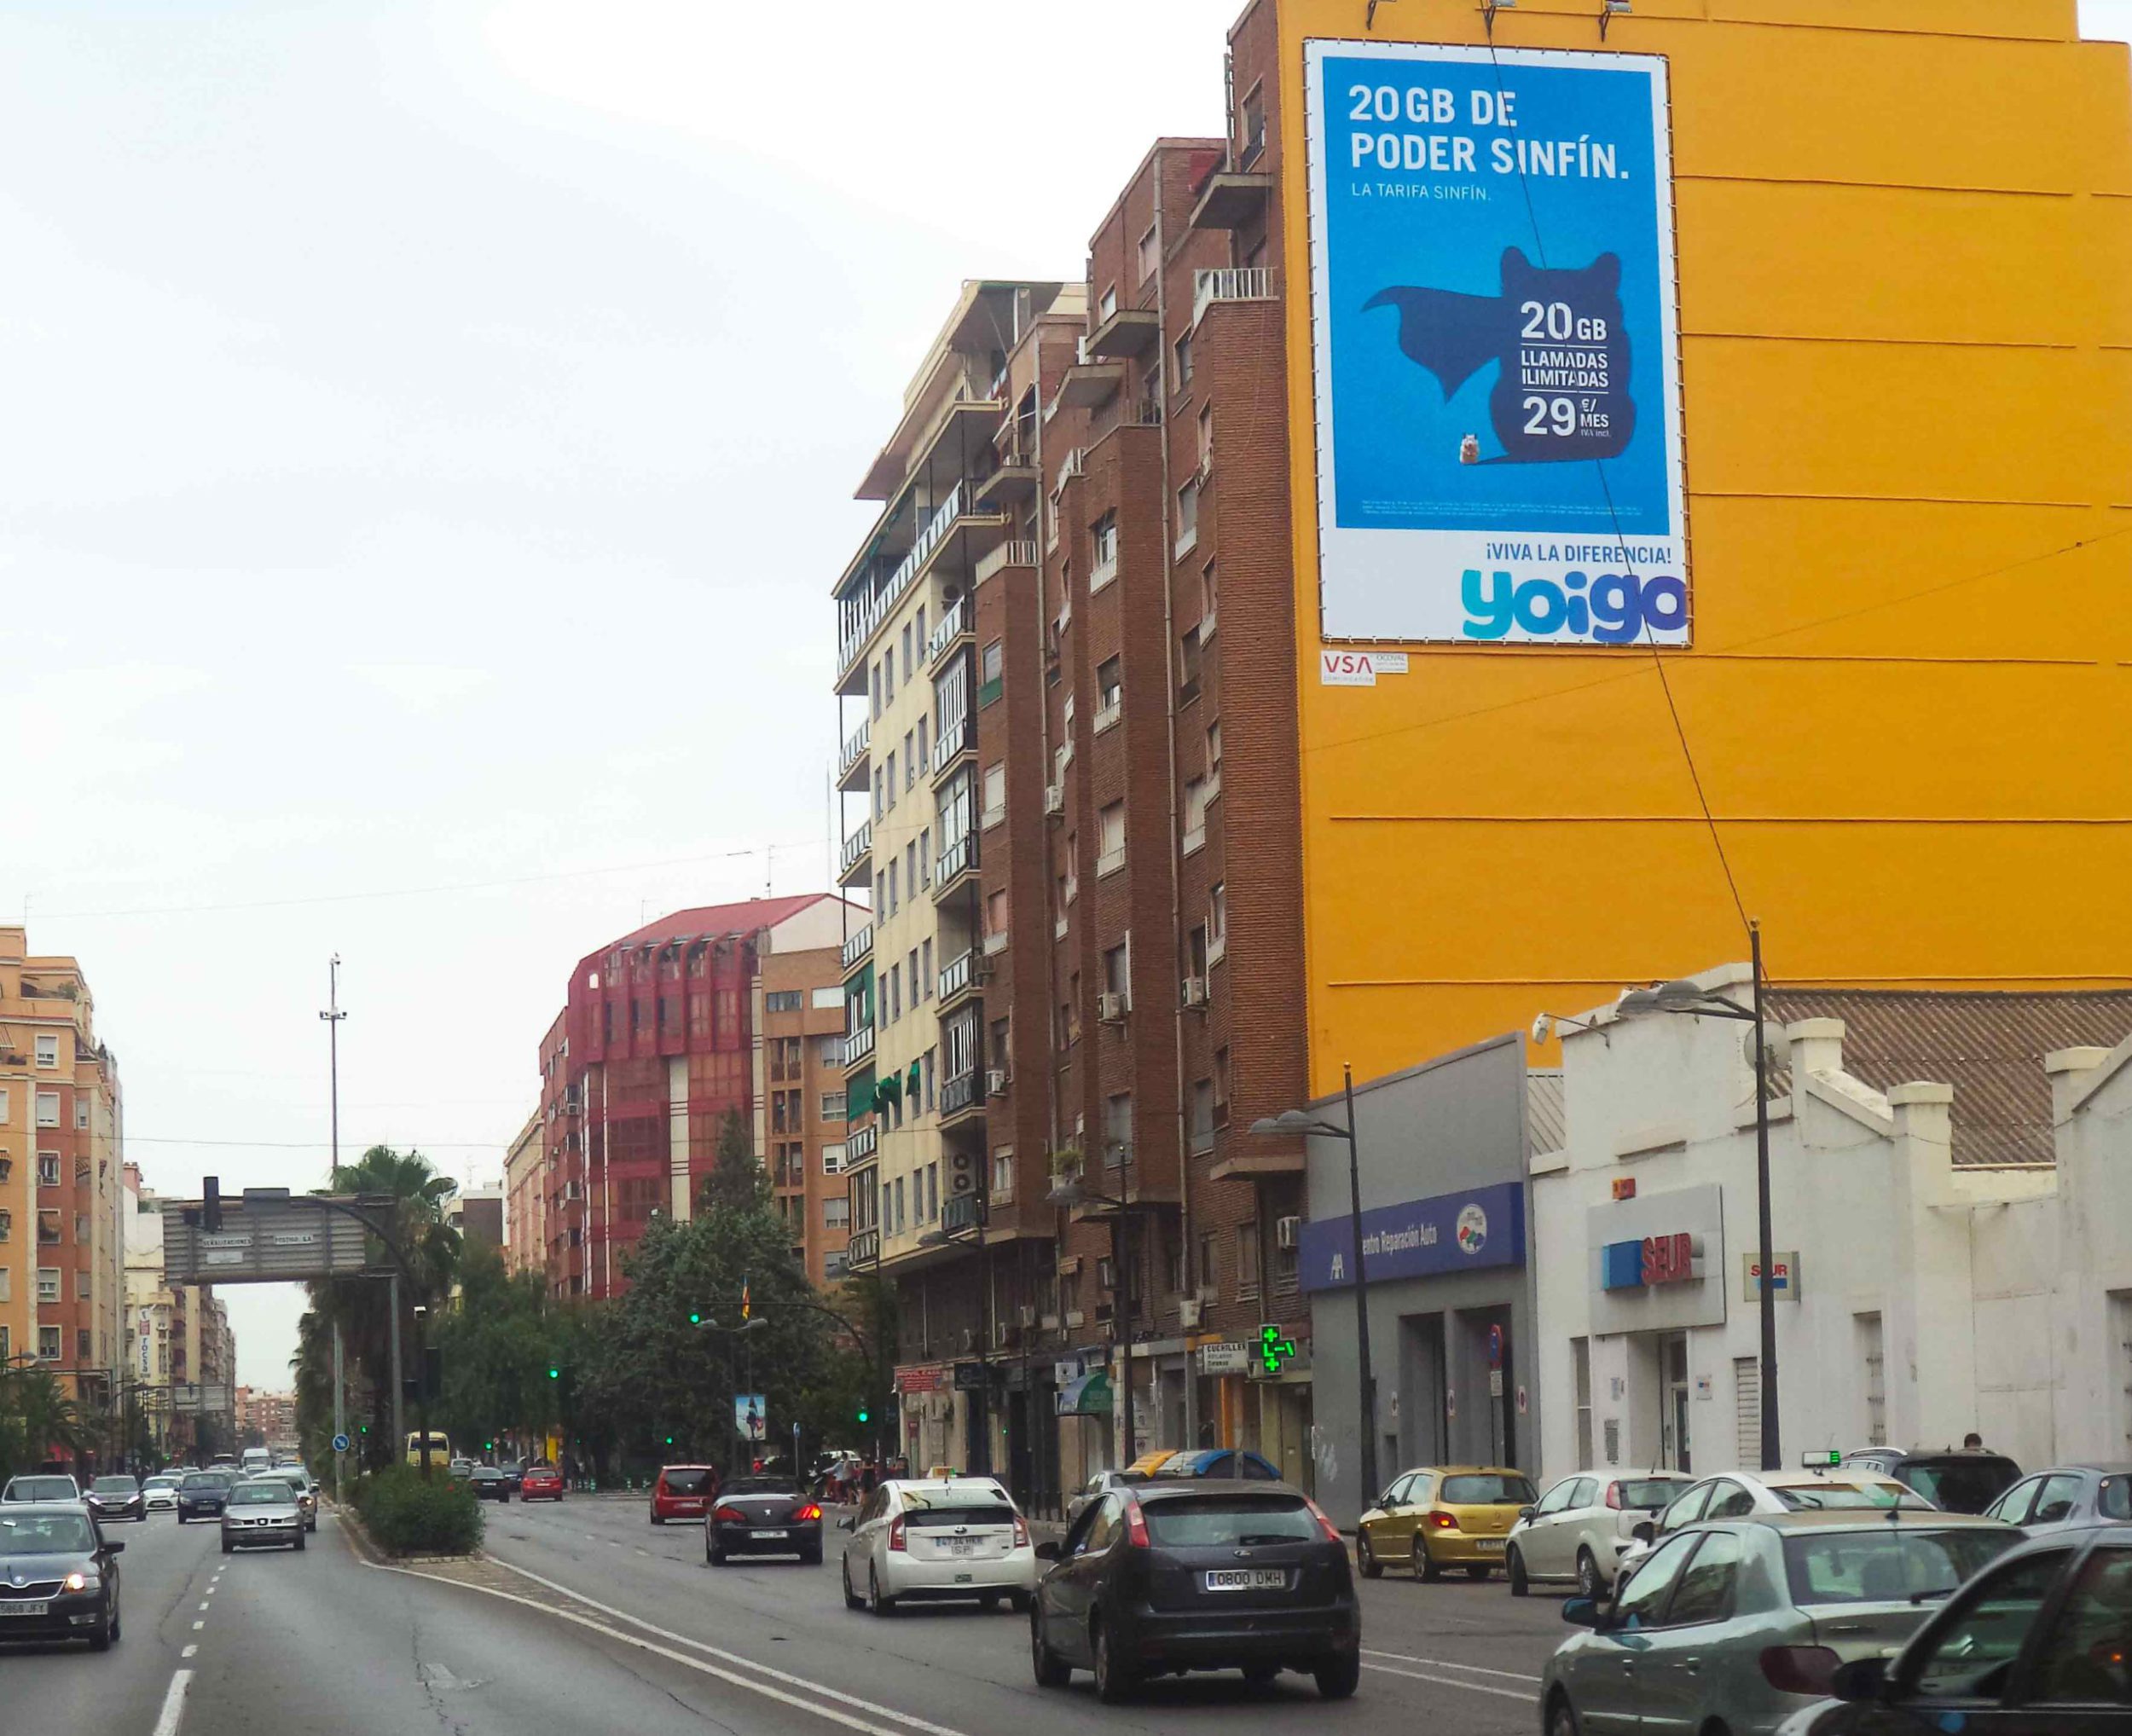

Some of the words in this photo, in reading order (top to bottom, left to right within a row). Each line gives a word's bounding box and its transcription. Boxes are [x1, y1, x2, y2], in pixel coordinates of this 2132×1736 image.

[1471, 90, 1518, 127] DE
[1351, 132, 1476, 172] PODER
[1491, 134, 1630, 180] SINFÍN.
[1351, 182, 1372, 197] LA
[1378, 183, 1429, 199] TARIFA
[1434, 184, 1492, 201] SINFÍN.
[1521, 350, 1609, 369] LLAMADAS
[1521, 367, 1610, 388] ILIMITADAS
[1523, 396, 1577, 437] 29
[1580, 413, 1609, 427] MES
[1581, 428, 1594, 437] IVA
[1486, 542, 1532, 562] ¡VIVA
[1538, 544, 1560, 563] LA
[1564, 544, 1671, 564] DIFERENCIA!
[1461, 569, 1688, 644] yoigo
[1324, 655, 1373, 674] VSA
[1362, 1233, 1381, 1256] entro
[1382, 1224, 1420, 1257] Reparación
[1420, 1223, 1437, 1247] Auto
[1642, 1233, 1693, 1285] SEUR
